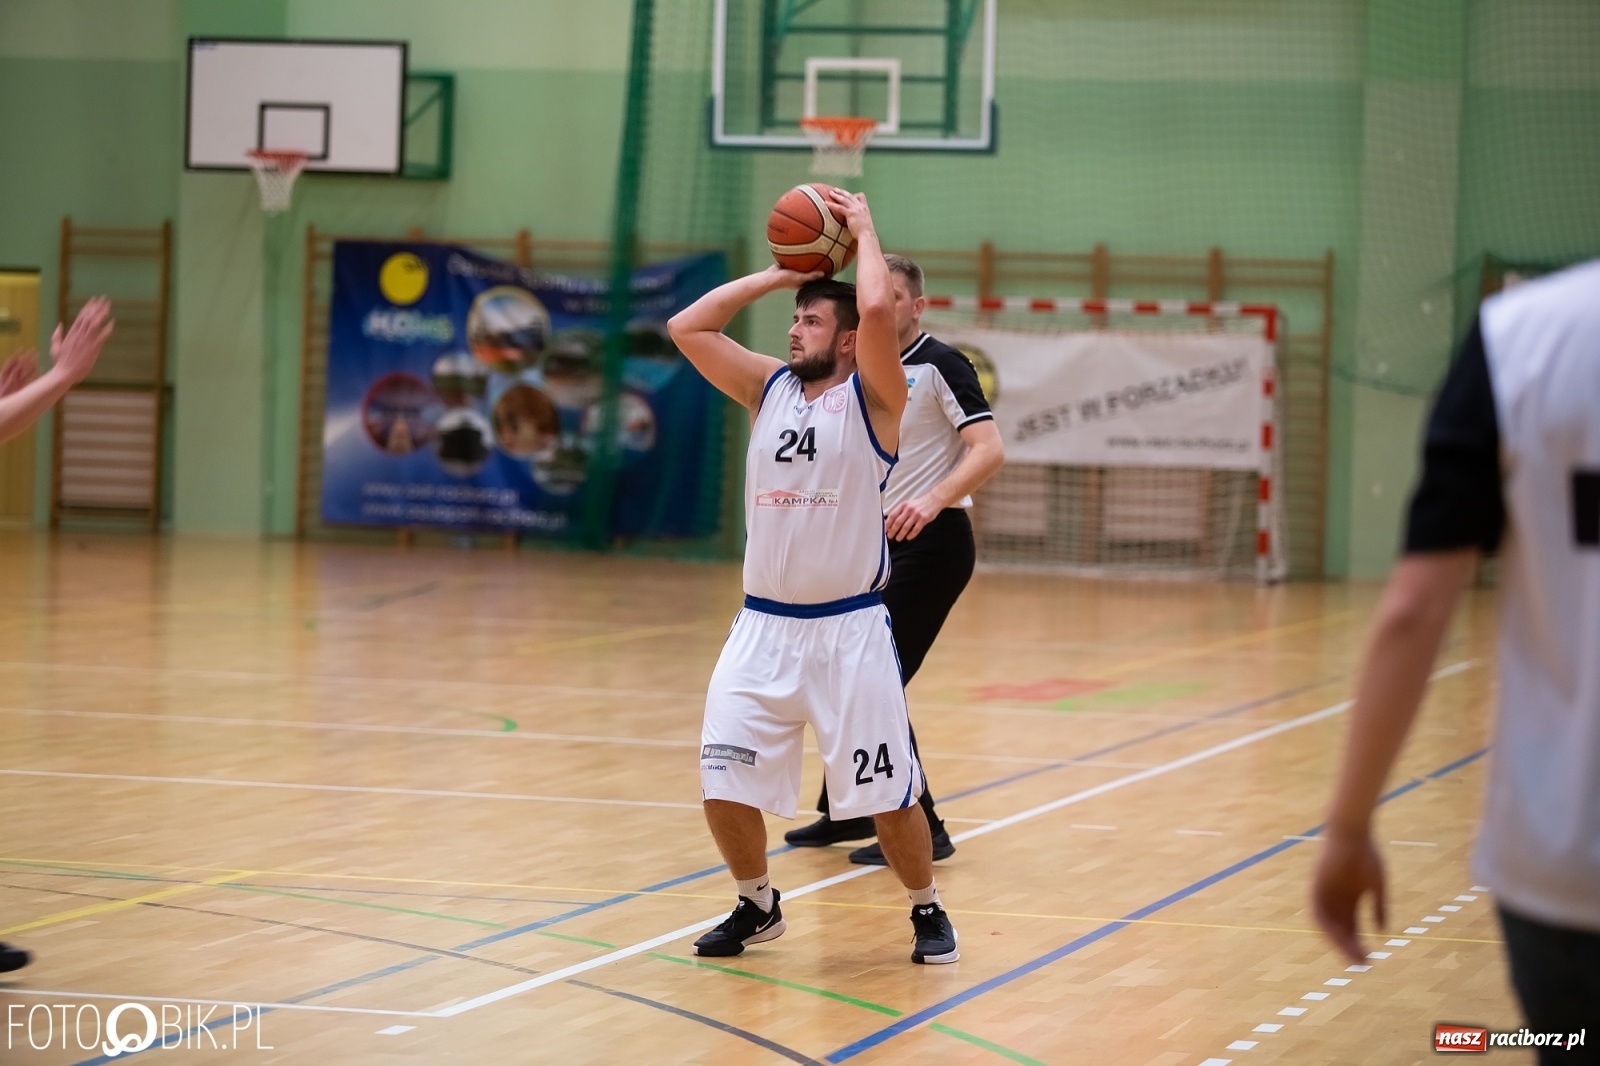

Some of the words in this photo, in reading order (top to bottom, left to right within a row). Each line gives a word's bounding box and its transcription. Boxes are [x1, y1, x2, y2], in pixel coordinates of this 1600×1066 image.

[775, 427, 817, 463] 24
[774, 497, 827, 505] KAMPKA
[853, 742, 894, 786] 24
